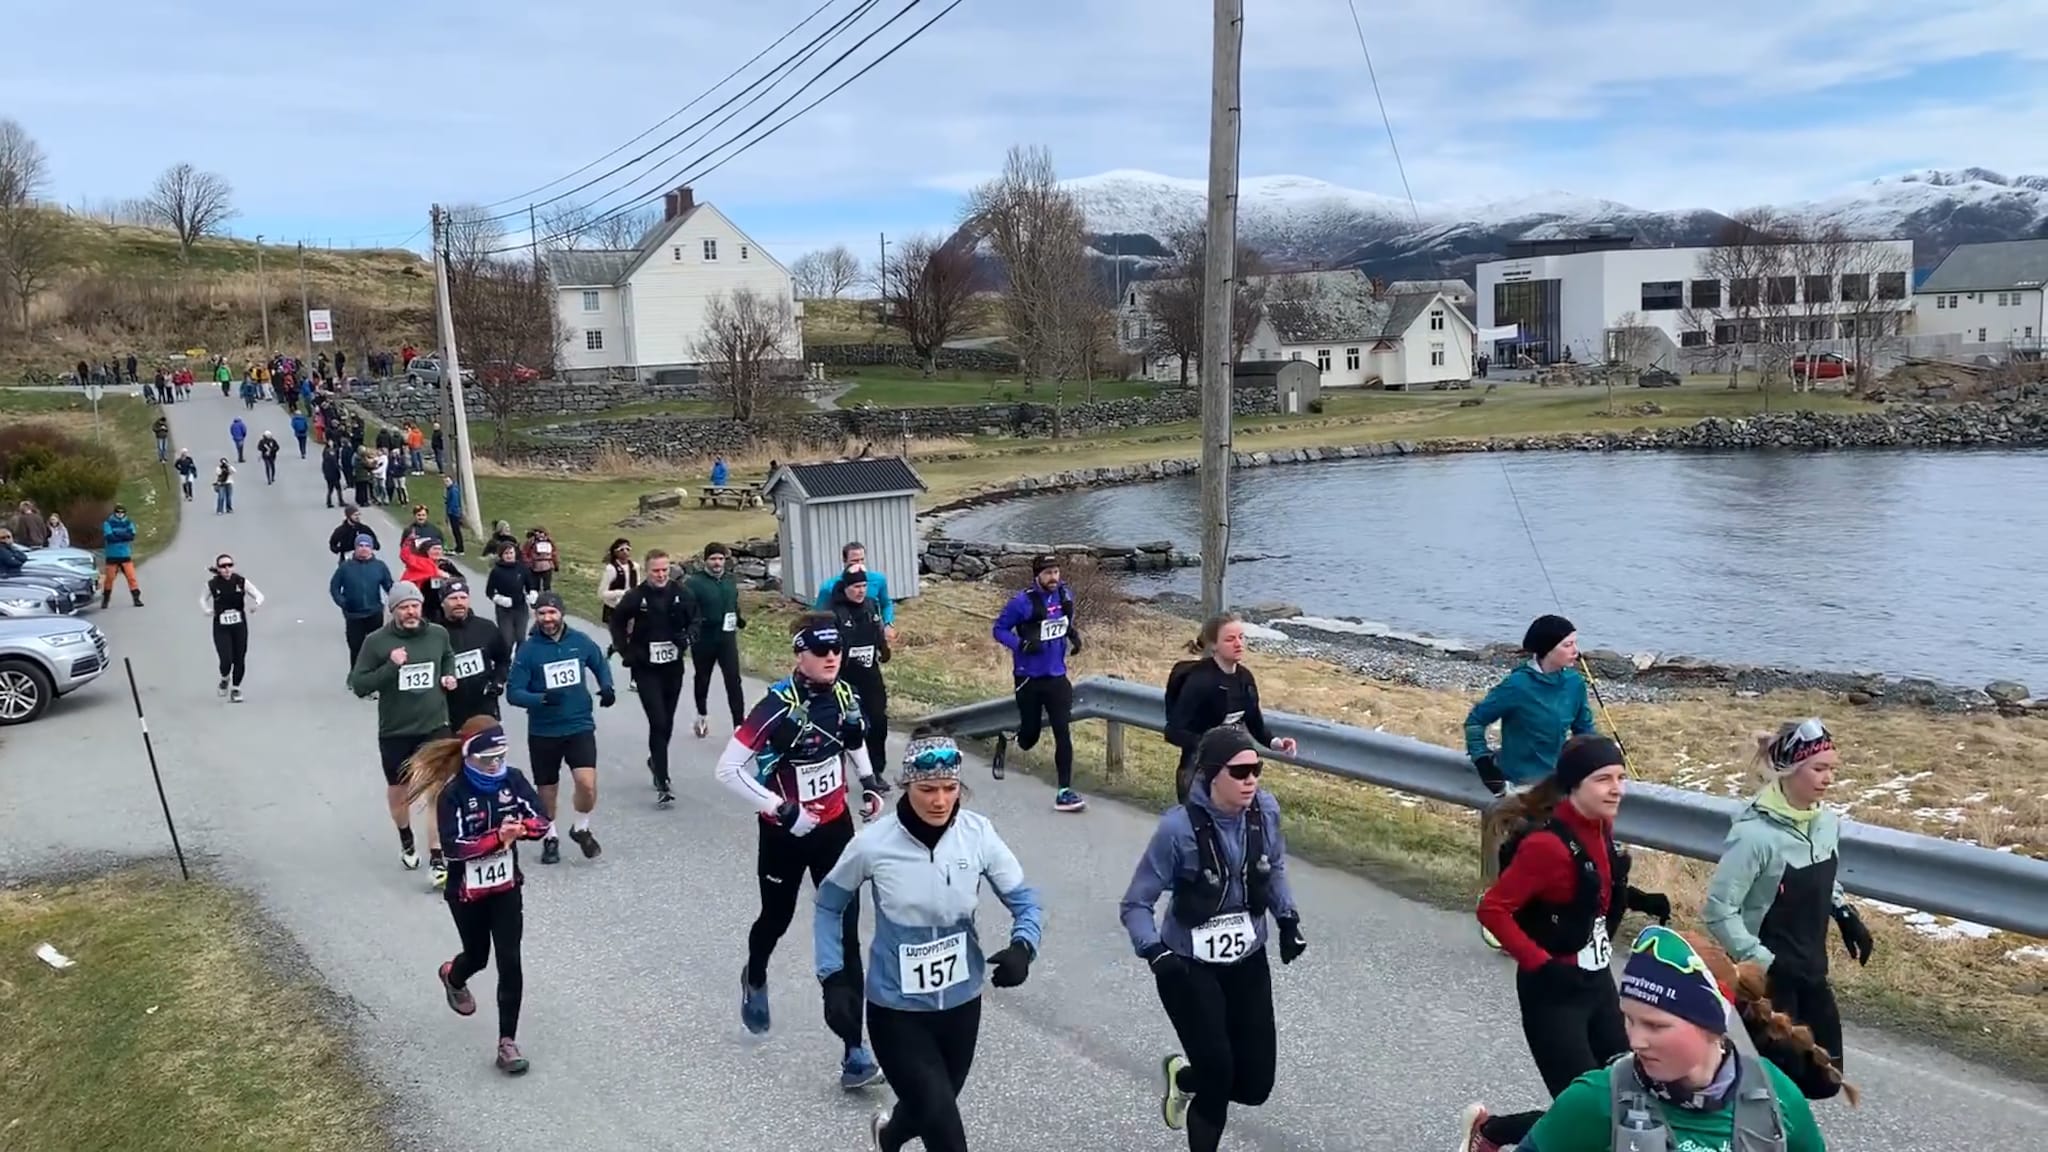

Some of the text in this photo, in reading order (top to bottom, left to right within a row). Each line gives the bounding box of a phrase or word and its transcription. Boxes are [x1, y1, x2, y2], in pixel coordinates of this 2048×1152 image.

[1046, 623, 1063, 638] 127
[656, 649, 674, 661] 105
[456, 659, 479, 676] 131
[406, 672, 430, 687] 132
[552, 668, 576, 686] 133
[807, 769, 836, 797] 151
[474, 861, 507, 885] 144
[1205, 932, 1246, 959] 125
[912, 953, 958, 990] 157
[1666, 987, 1677, 1001] IL
